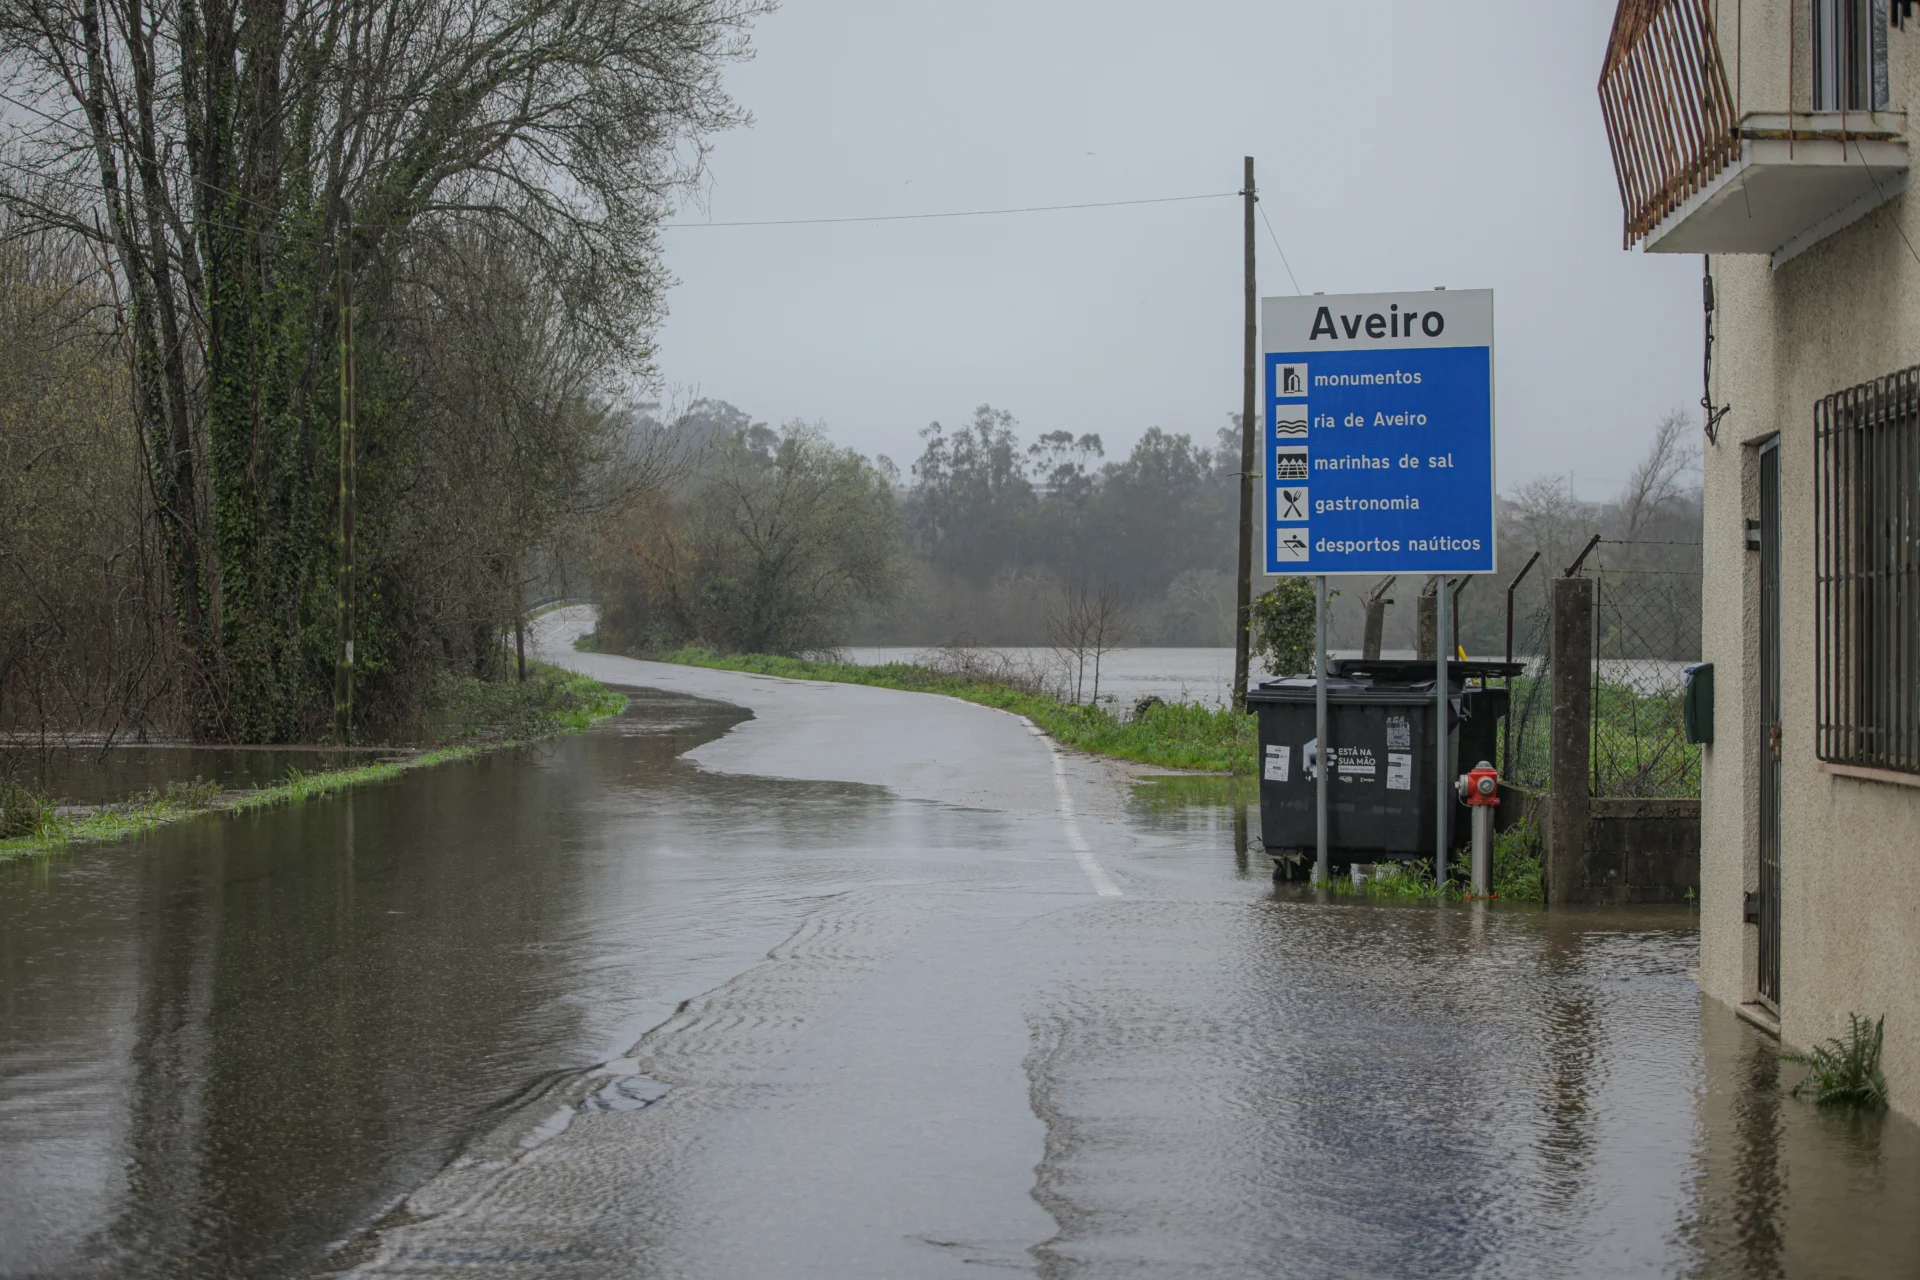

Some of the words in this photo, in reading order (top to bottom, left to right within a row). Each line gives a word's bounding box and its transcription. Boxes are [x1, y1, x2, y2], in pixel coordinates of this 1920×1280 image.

[1309, 304, 1444, 340] Aveiro
[1314, 370, 1422, 387] monumentos
[1314, 413, 1335, 428] ria
[1344, 413, 1365, 428] de
[1373, 411, 1427, 427] Aveiro
[1314, 455, 1390, 470] marinhas
[1399, 454, 1420, 469] de
[1428, 453, 1454, 468] sal
[1315, 495, 1420, 514] gastronomia
[1315, 537, 1400, 555] desportos
[1408, 536, 1481, 551] naúticos
[1338, 746, 1359, 756] ESTÁ
[1359, 748, 1372, 756] NA
[1338, 757, 1355, 765] SUA
[1356, 756, 1376, 766] MÃO
